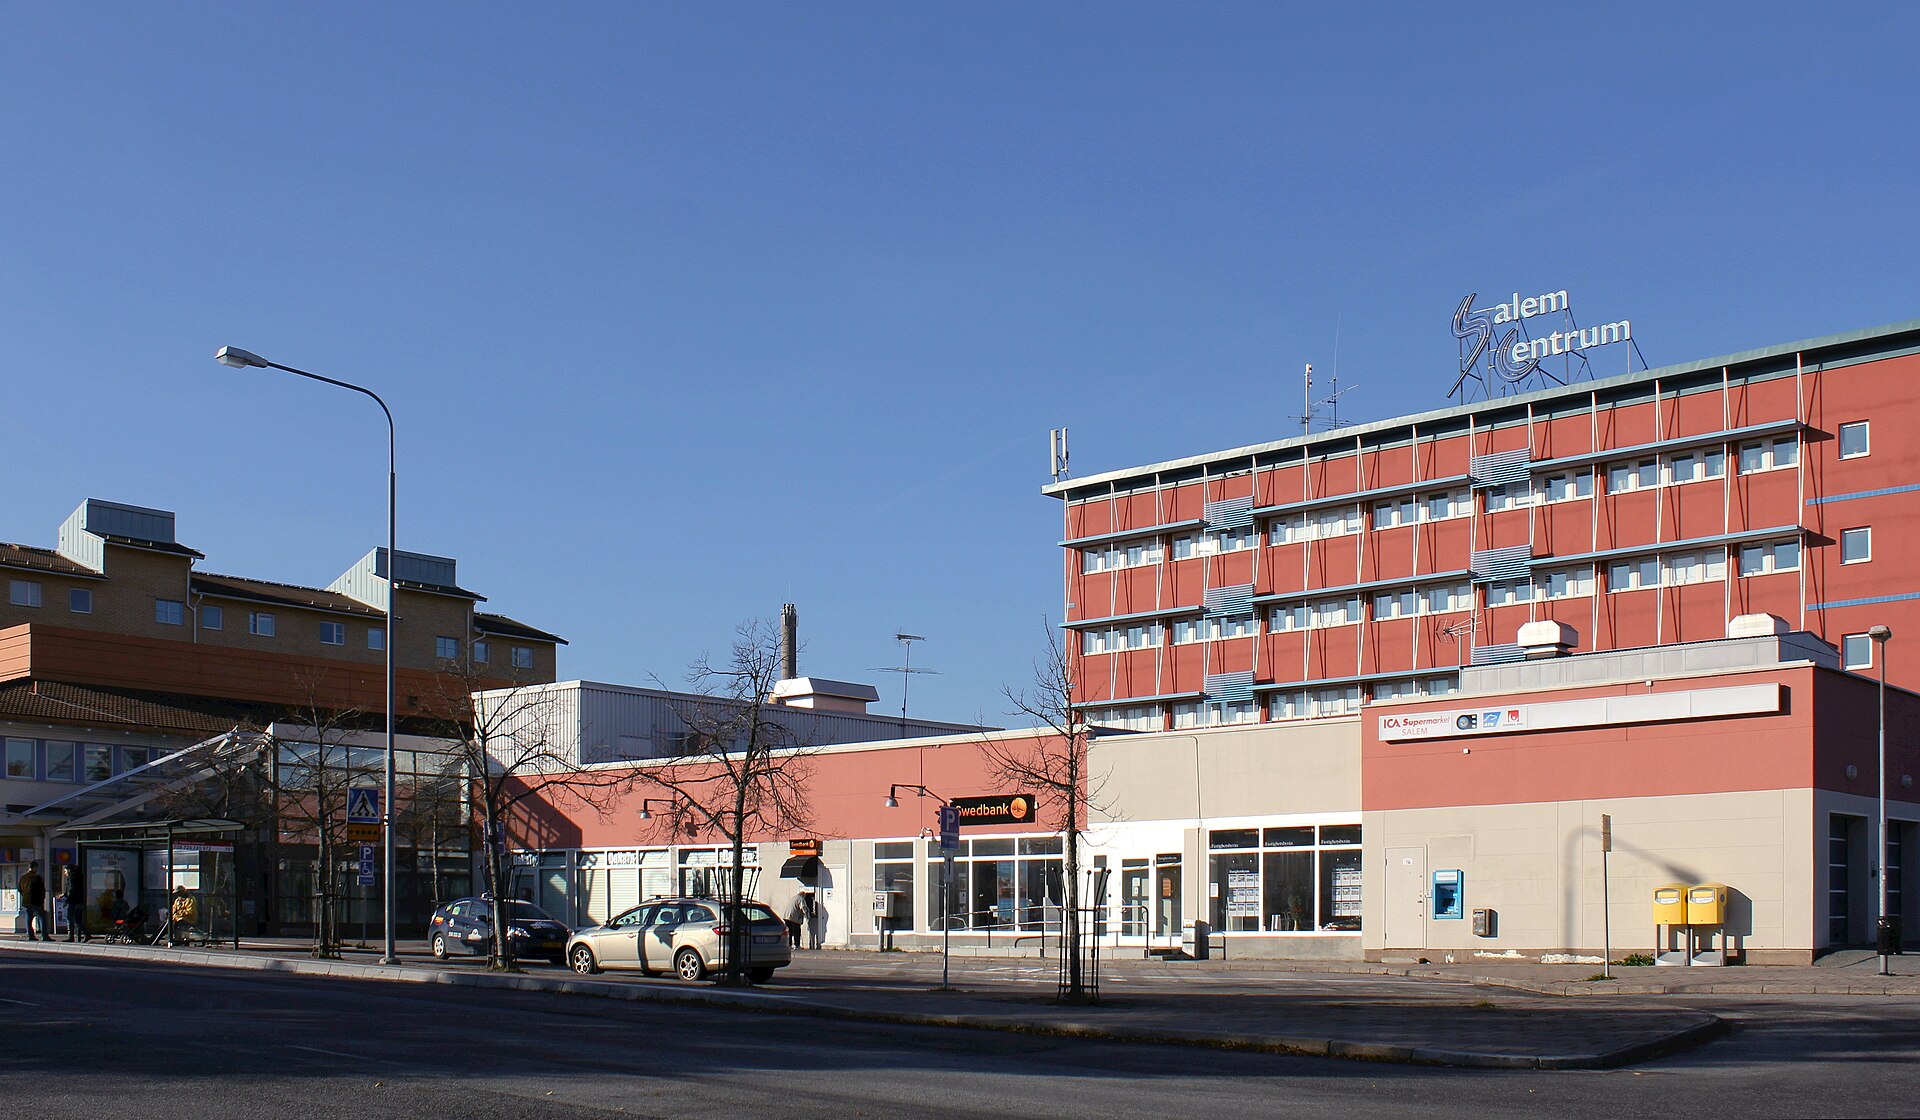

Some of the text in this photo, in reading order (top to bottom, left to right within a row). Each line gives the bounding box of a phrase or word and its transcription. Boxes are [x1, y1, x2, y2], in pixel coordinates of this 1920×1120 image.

[1447, 289, 1569, 398] Salem
[1494, 319, 1631, 383] Centrum
[1384, 715, 1450, 729] ICA Supermarket
[1401, 727, 1428, 736] SALEM
[946, 809, 955, 831] P
[363, 847, 372, 859] P
